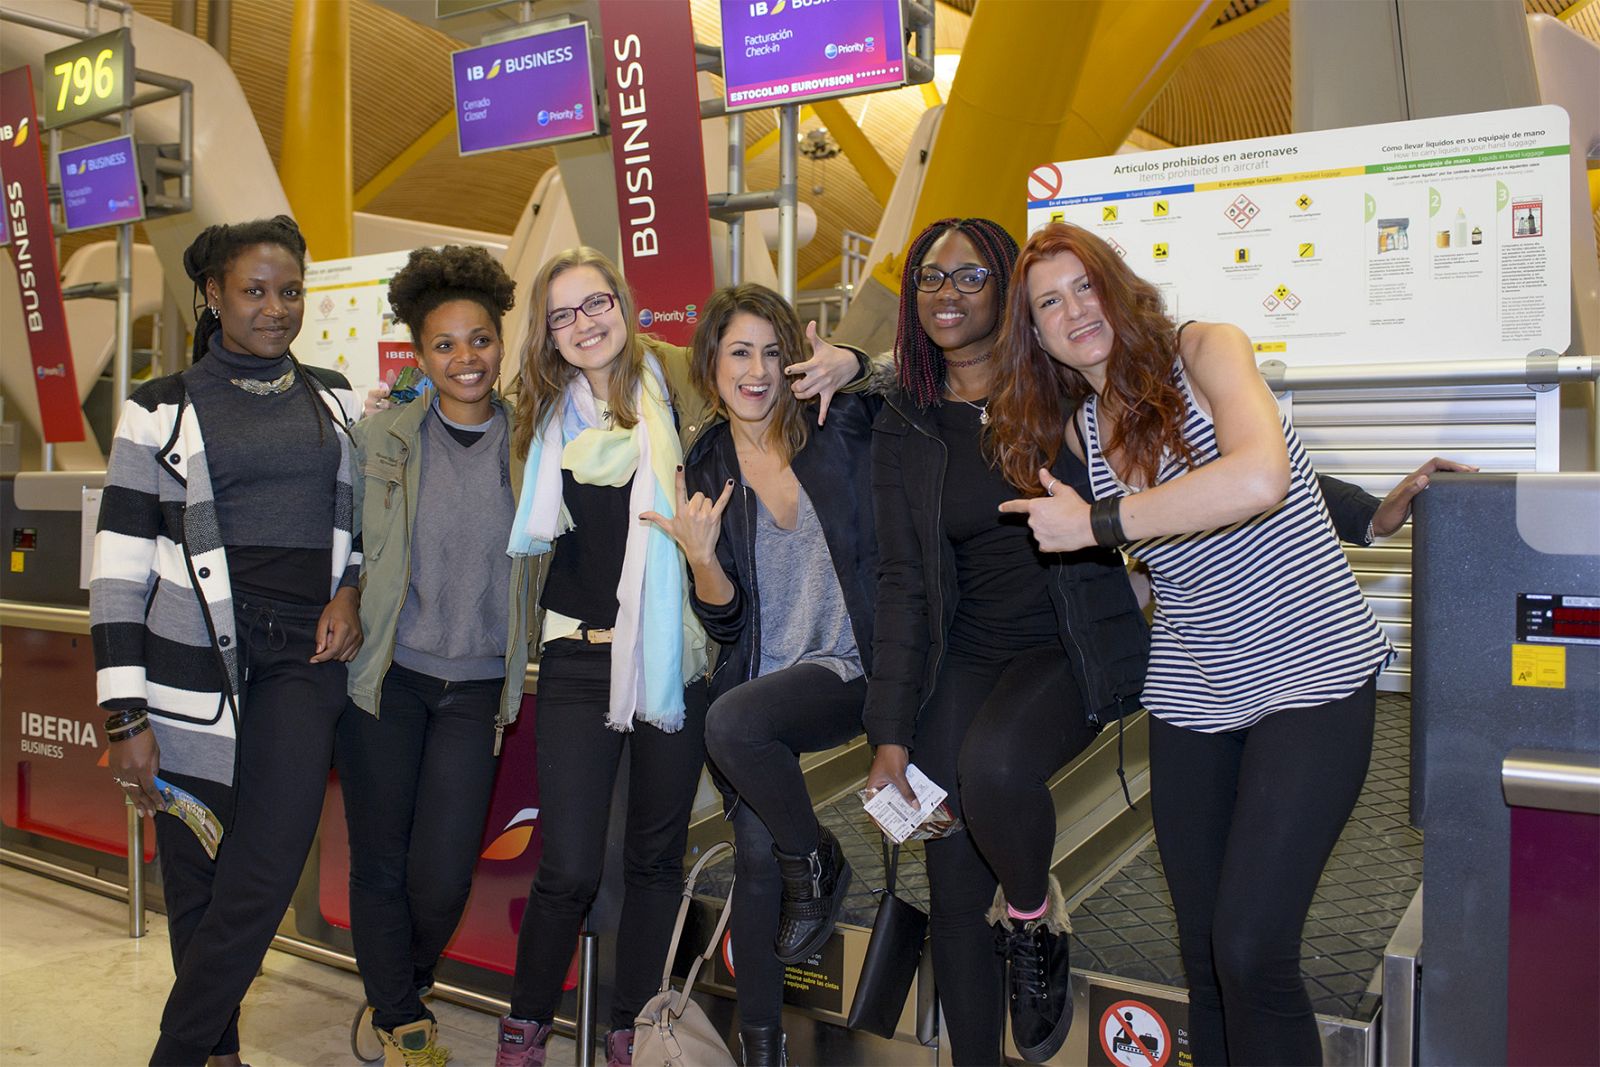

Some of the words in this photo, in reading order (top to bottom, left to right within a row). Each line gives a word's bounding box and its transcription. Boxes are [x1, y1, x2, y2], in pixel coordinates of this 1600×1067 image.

[748, 2, 768, 17] IB
[744, 28, 793, 46] Facturación
[745, 42, 780, 58] Check-in
[838, 42, 864, 54] Priority
[467, 66, 485, 81] IB
[505, 46, 573, 74] BUSINESS
[54, 49, 114, 112] 796
[730, 83, 790, 102] ESTOCOLMO
[791, 73, 854, 93] EUROVISION
[463, 97, 491, 111] Cerrado
[464, 109, 488, 122] Closed
[549, 109, 574, 121] Priority
[1477, 133, 1510, 143] equipaje
[1523, 130, 1546, 138] mano
[613, 33, 658, 257] BUSINESS
[66, 163, 78, 175] IB
[87, 152, 127, 171] BUSINESS
[1162, 156, 1220, 171] prohibidos
[1222, 154, 1237, 162] en
[1240, 147, 1299, 161] aeronaves
[1139, 172, 1165, 183] Items
[1167, 164, 1218, 180] prohibited
[1221, 165, 1231, 174] in
[1233, 160, 1270, 173] aircraft
[1431, 194, 1440, 208] 2
[1498, 188, 1508, 201] 3
[1367, 200, 1374, 213] 1
[7, 181, 43, 332] BUSINESS
[653, 309, 685, 322] Priority
[385, 350, 415, 359] IBER
[21, 711, 98, 748] IBERIA
[21, 739, 64, 759] BUSINESS
[1178, 1028, 1188, 1037] Do
